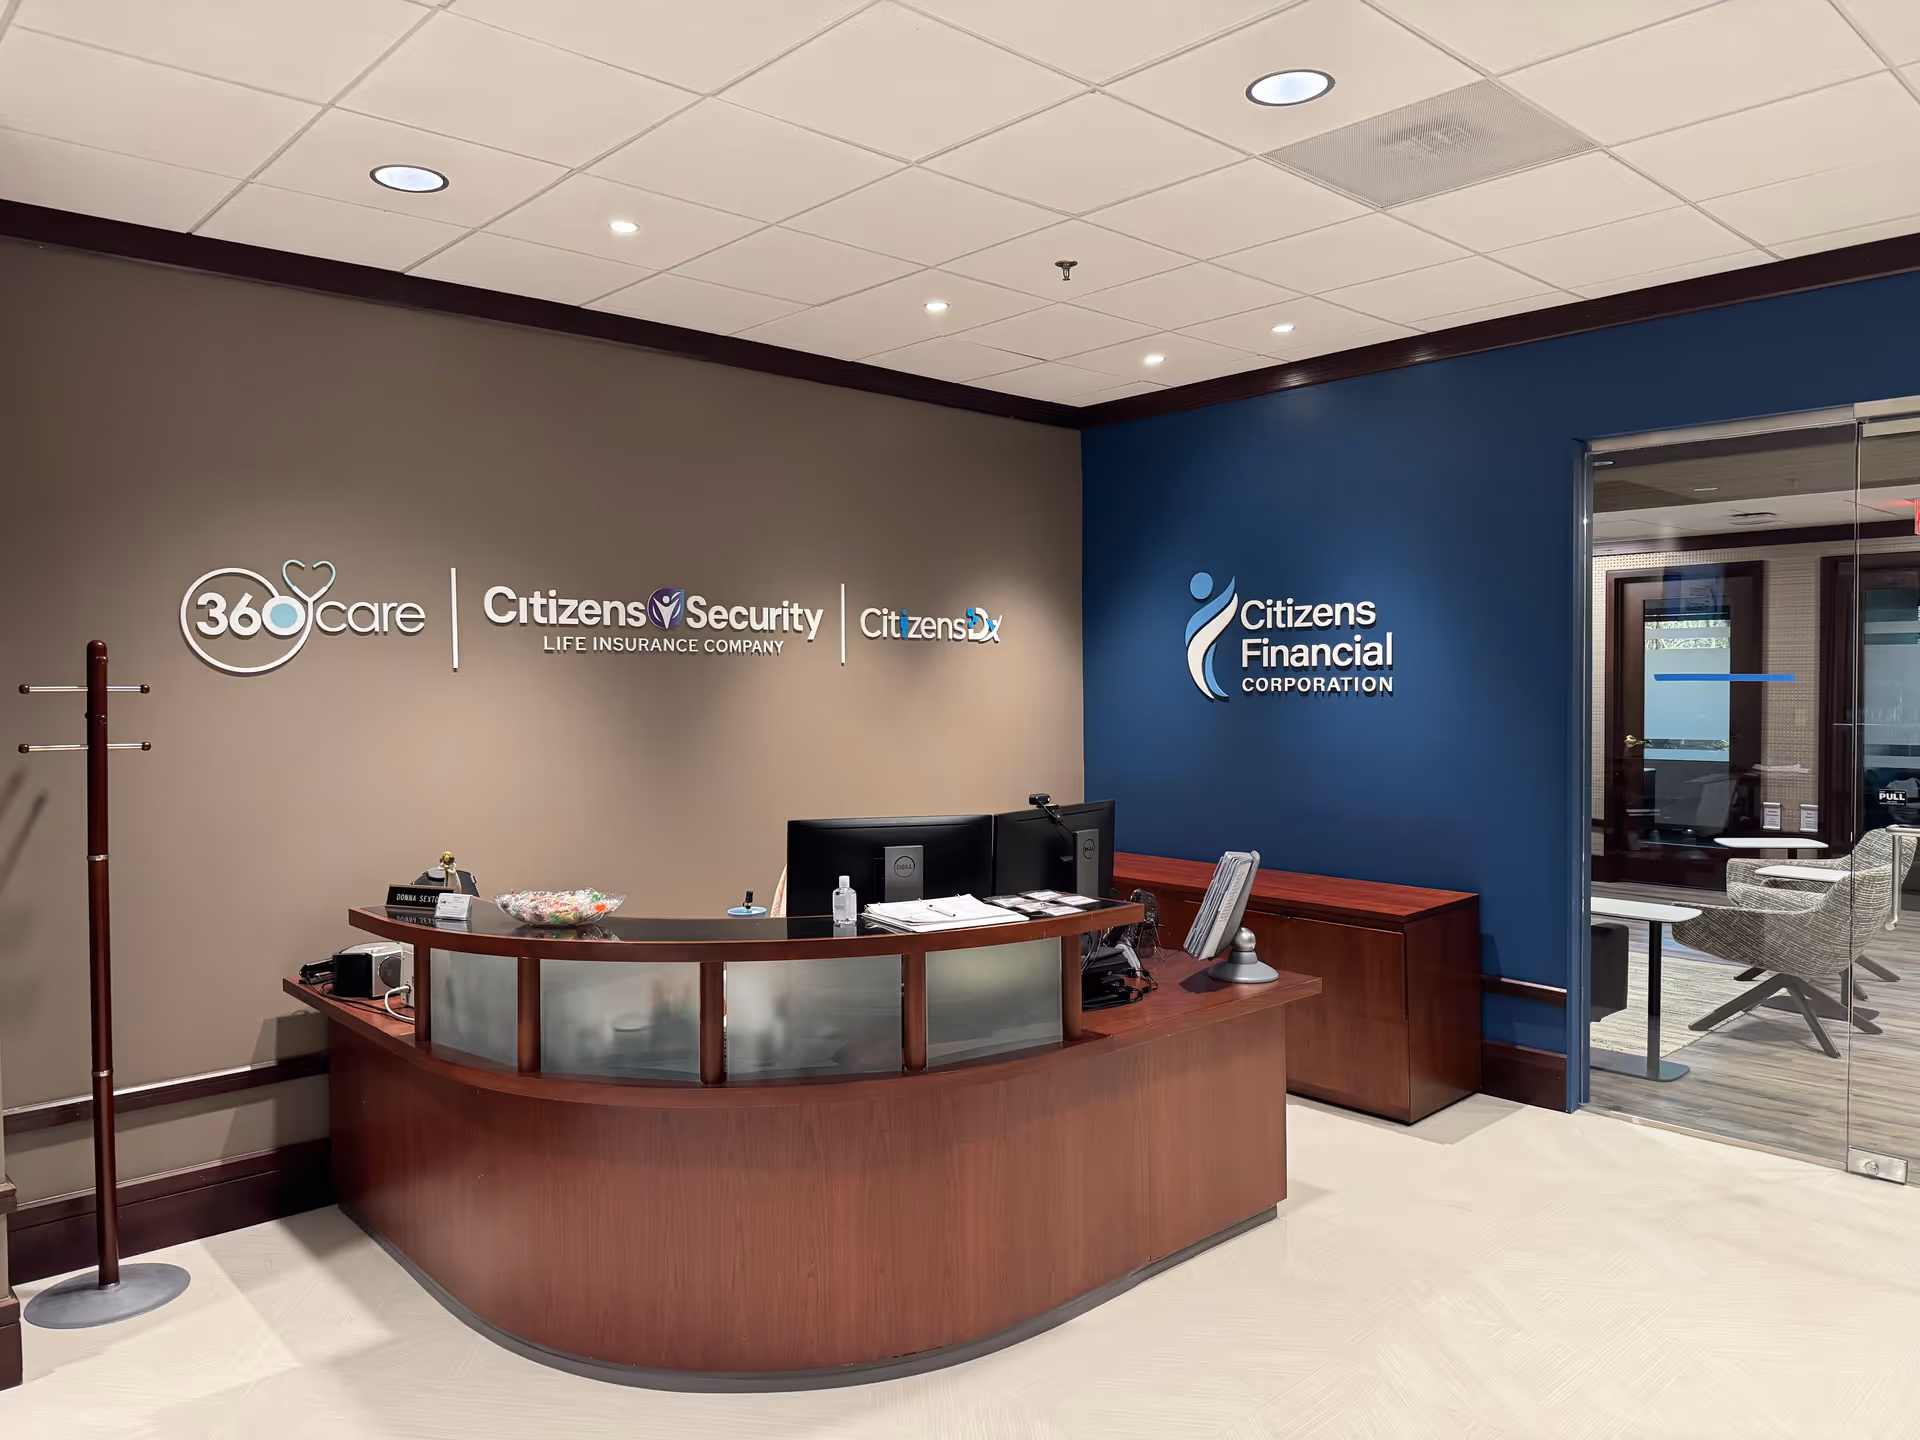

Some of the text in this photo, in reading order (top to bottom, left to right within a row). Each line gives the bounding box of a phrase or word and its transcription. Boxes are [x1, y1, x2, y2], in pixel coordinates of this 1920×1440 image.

[483, 585, 824, 641] Citizens Security
[1240, 597, 1377, 631] Citizens
[543, 635, 785, 655] LIFE INSURANCE COMPANY
[1241, 631, 1393, 668] Financial
[1241, 676, 1394, 693] CORPORATION
[1878, 792, 1906, 801] PULL
[396, 893, 439, 904] DONNA SEXTO
